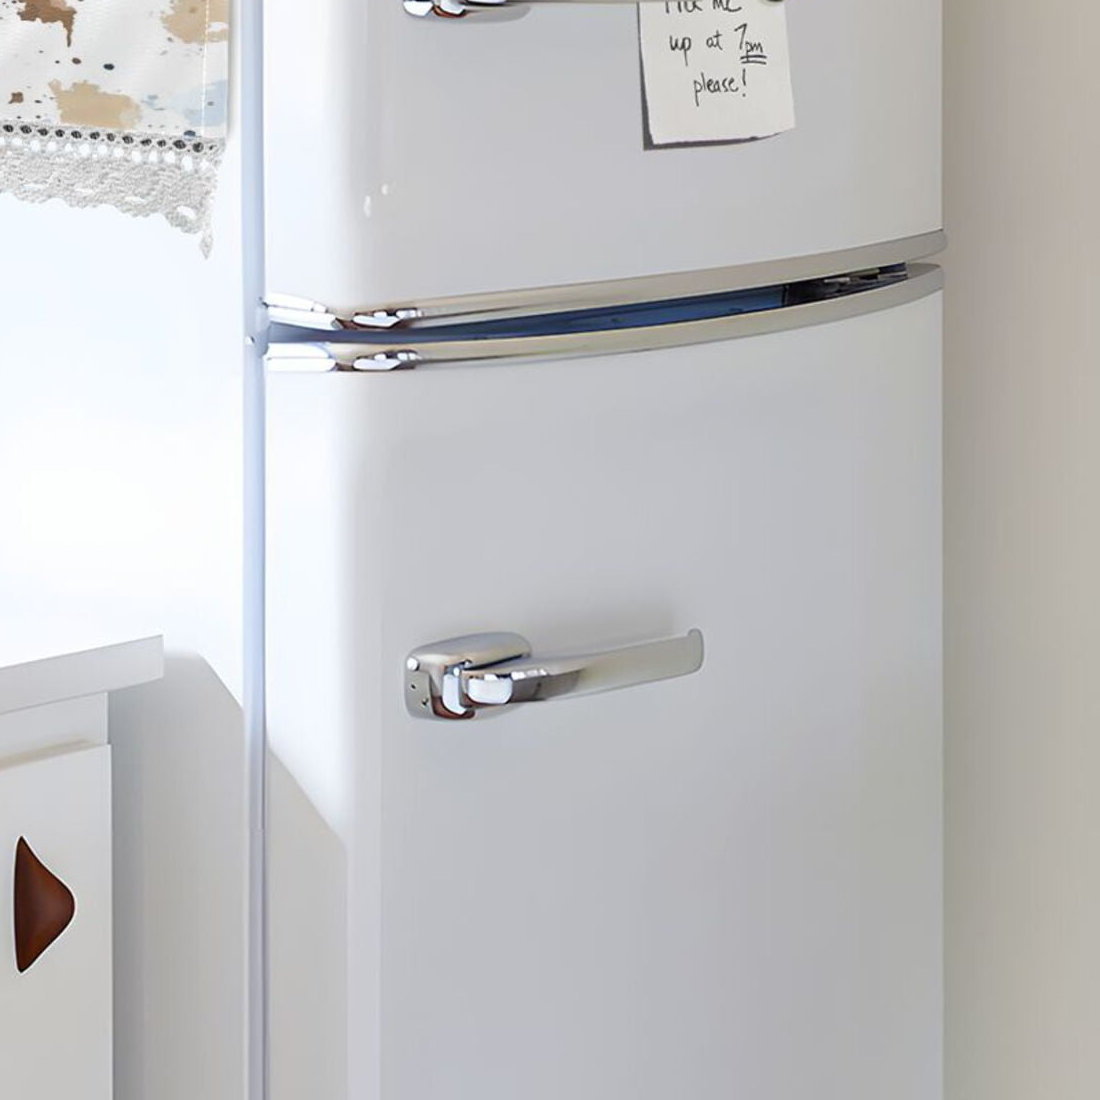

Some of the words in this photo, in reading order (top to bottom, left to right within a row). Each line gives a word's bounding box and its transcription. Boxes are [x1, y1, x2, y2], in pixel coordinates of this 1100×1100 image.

[669, 34, 692, 67] up
[706, 29, 723, 51] at
[693, 68, 747, 107] please!
